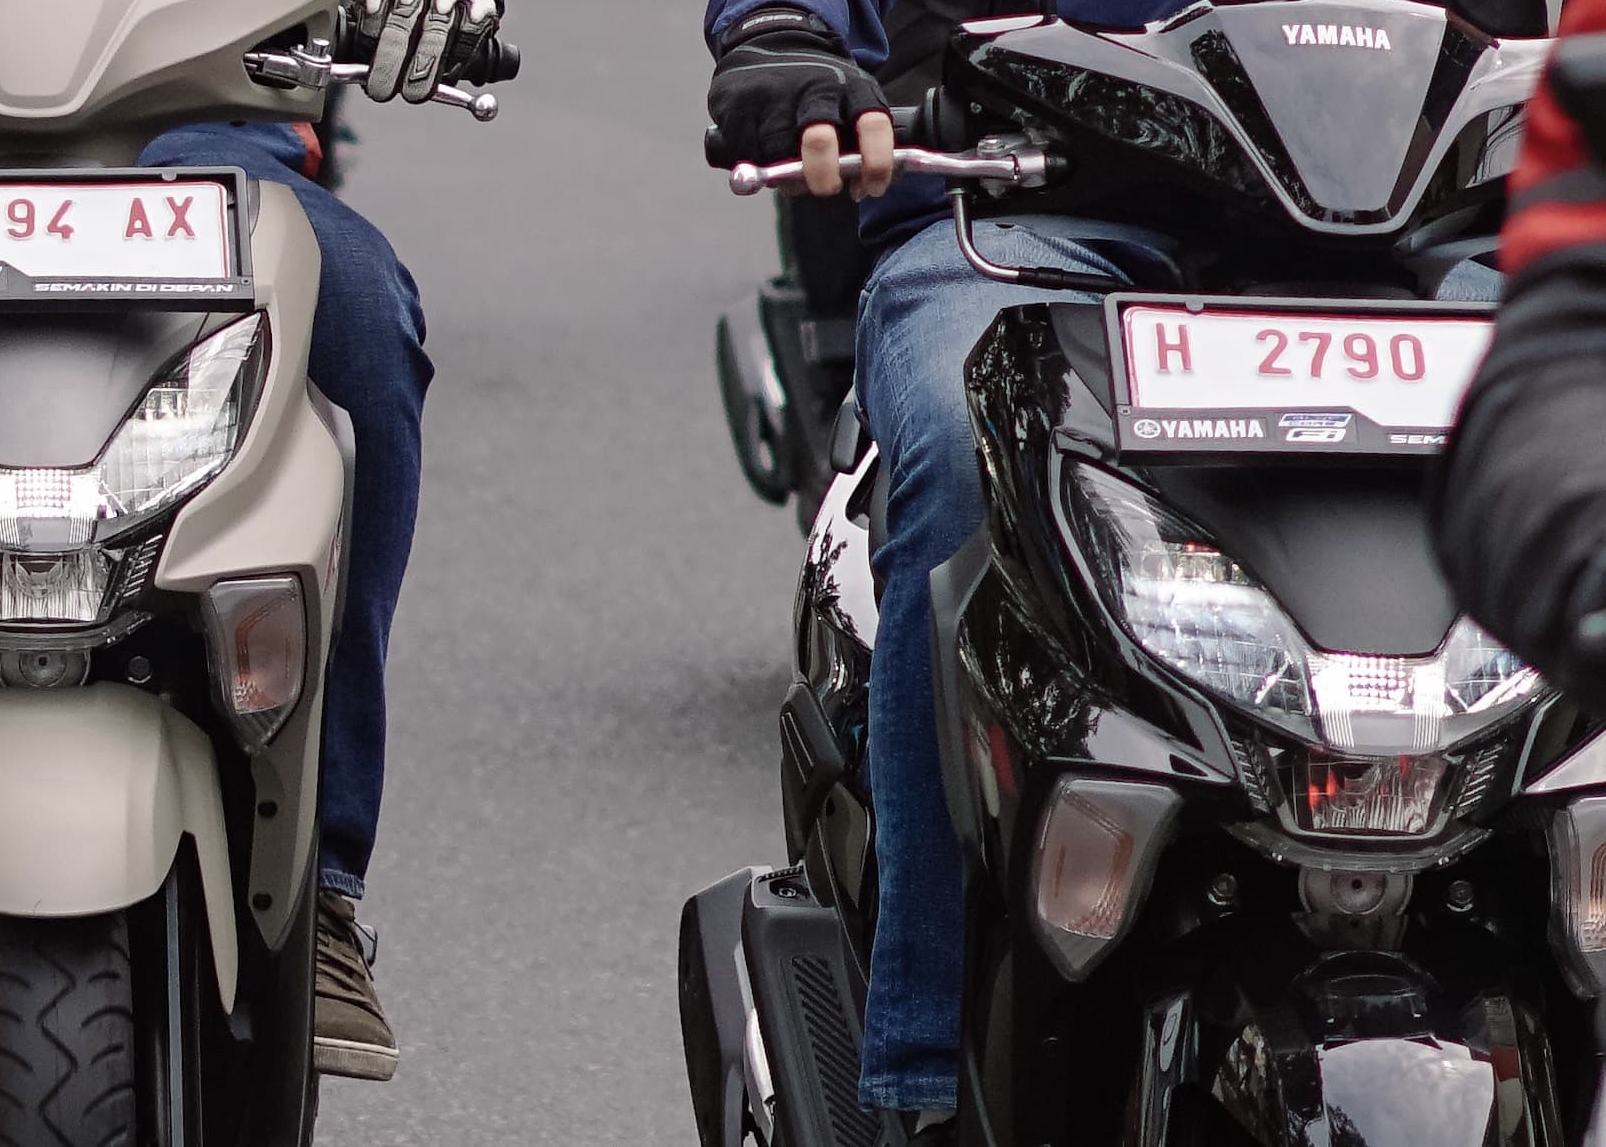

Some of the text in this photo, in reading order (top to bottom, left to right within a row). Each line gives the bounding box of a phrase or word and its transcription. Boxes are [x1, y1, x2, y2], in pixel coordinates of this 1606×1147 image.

[1282, 24, 1392, 51] YAMAHA
[125, 195, 196, 239] AX
[34, 283, 234, 293] SEMAKIN DI DEPAN
[1155, 322, 1427, 382] H 2790
[1161, 419, 1265, 439] YAMAHA
